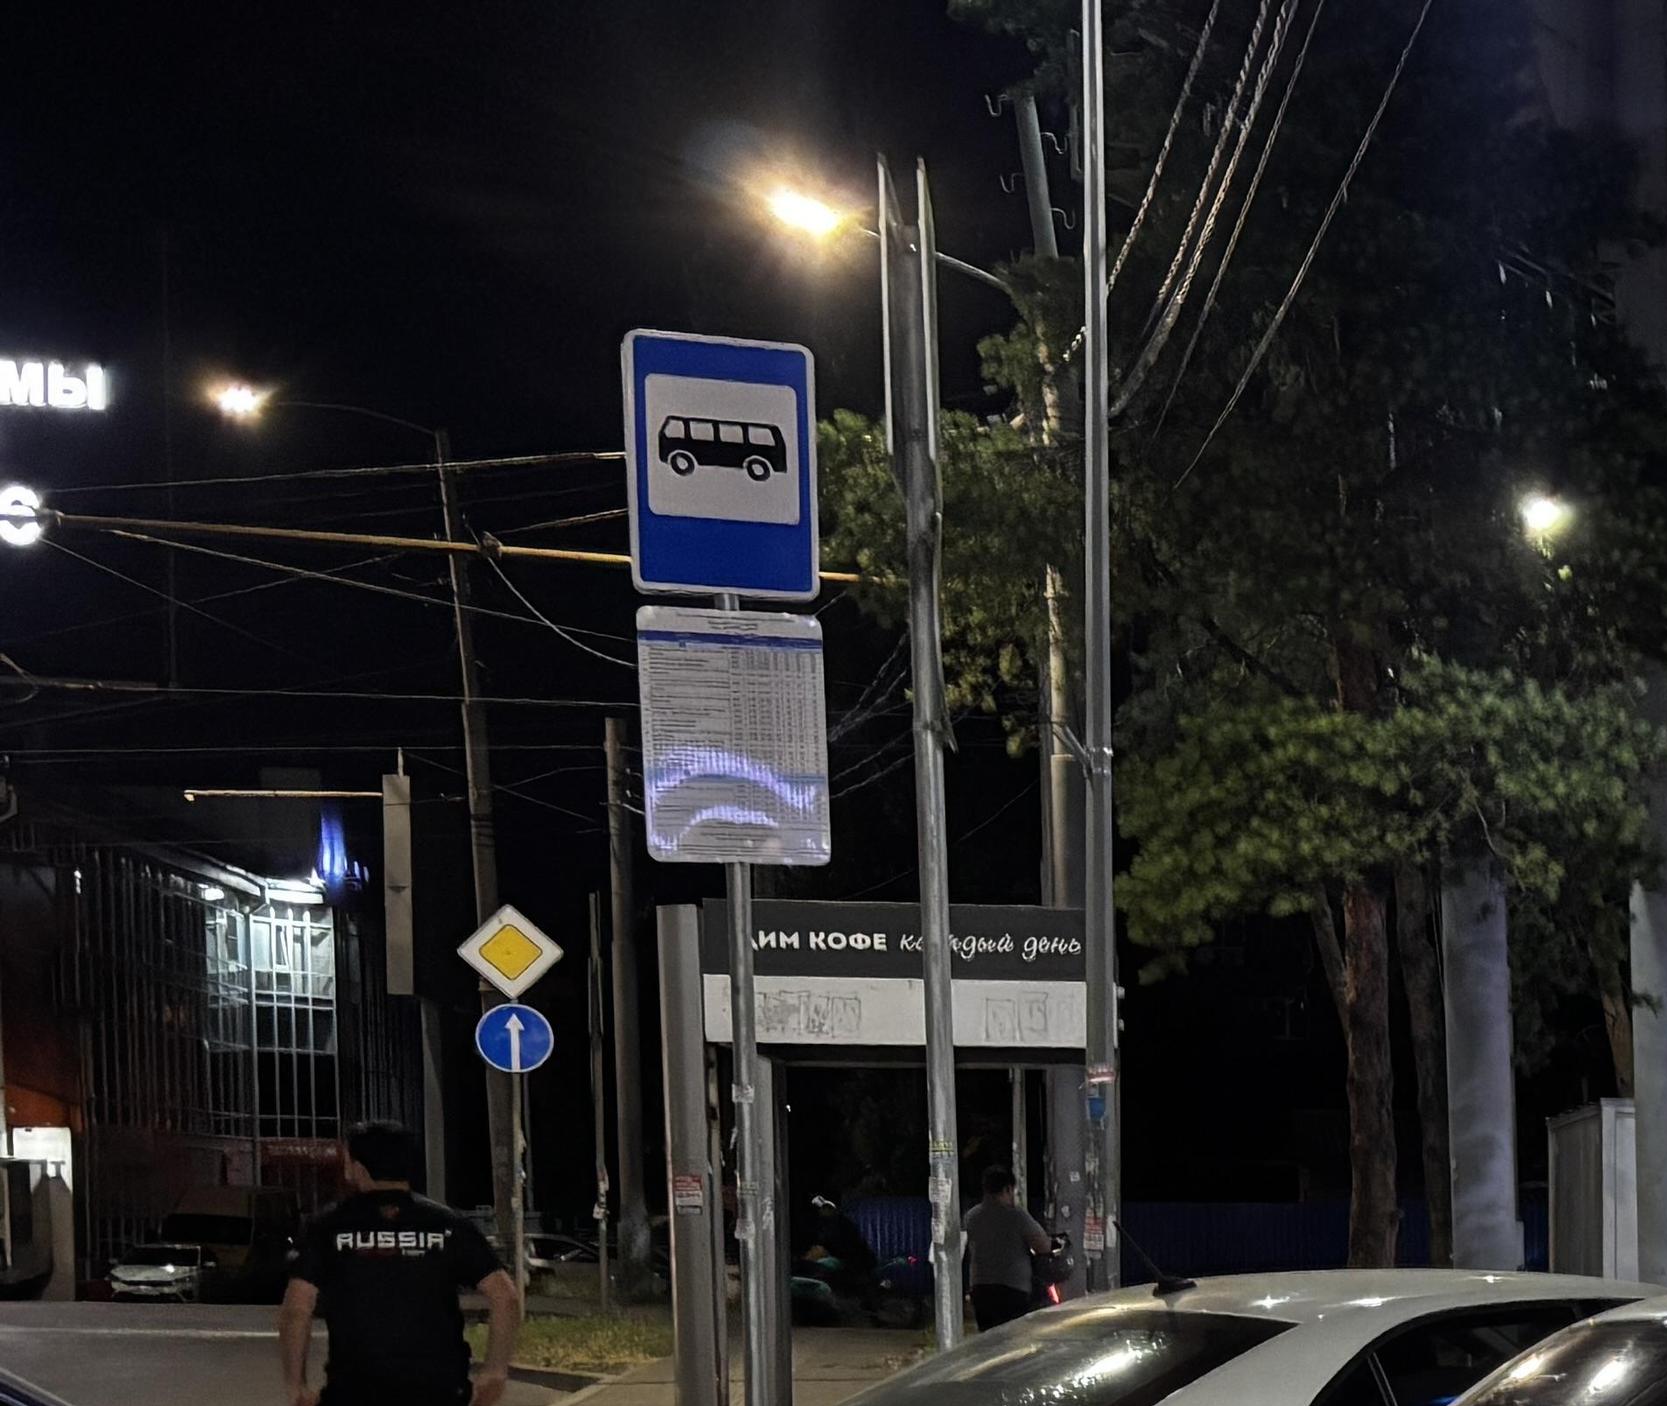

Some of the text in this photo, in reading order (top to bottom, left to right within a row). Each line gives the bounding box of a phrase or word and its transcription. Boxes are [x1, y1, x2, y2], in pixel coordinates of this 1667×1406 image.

[751, 930, 800, 951] ИМ
[809, 931, 887, 951] КОФЕ
[336, 1231, 444, 1251] RUSSIA
